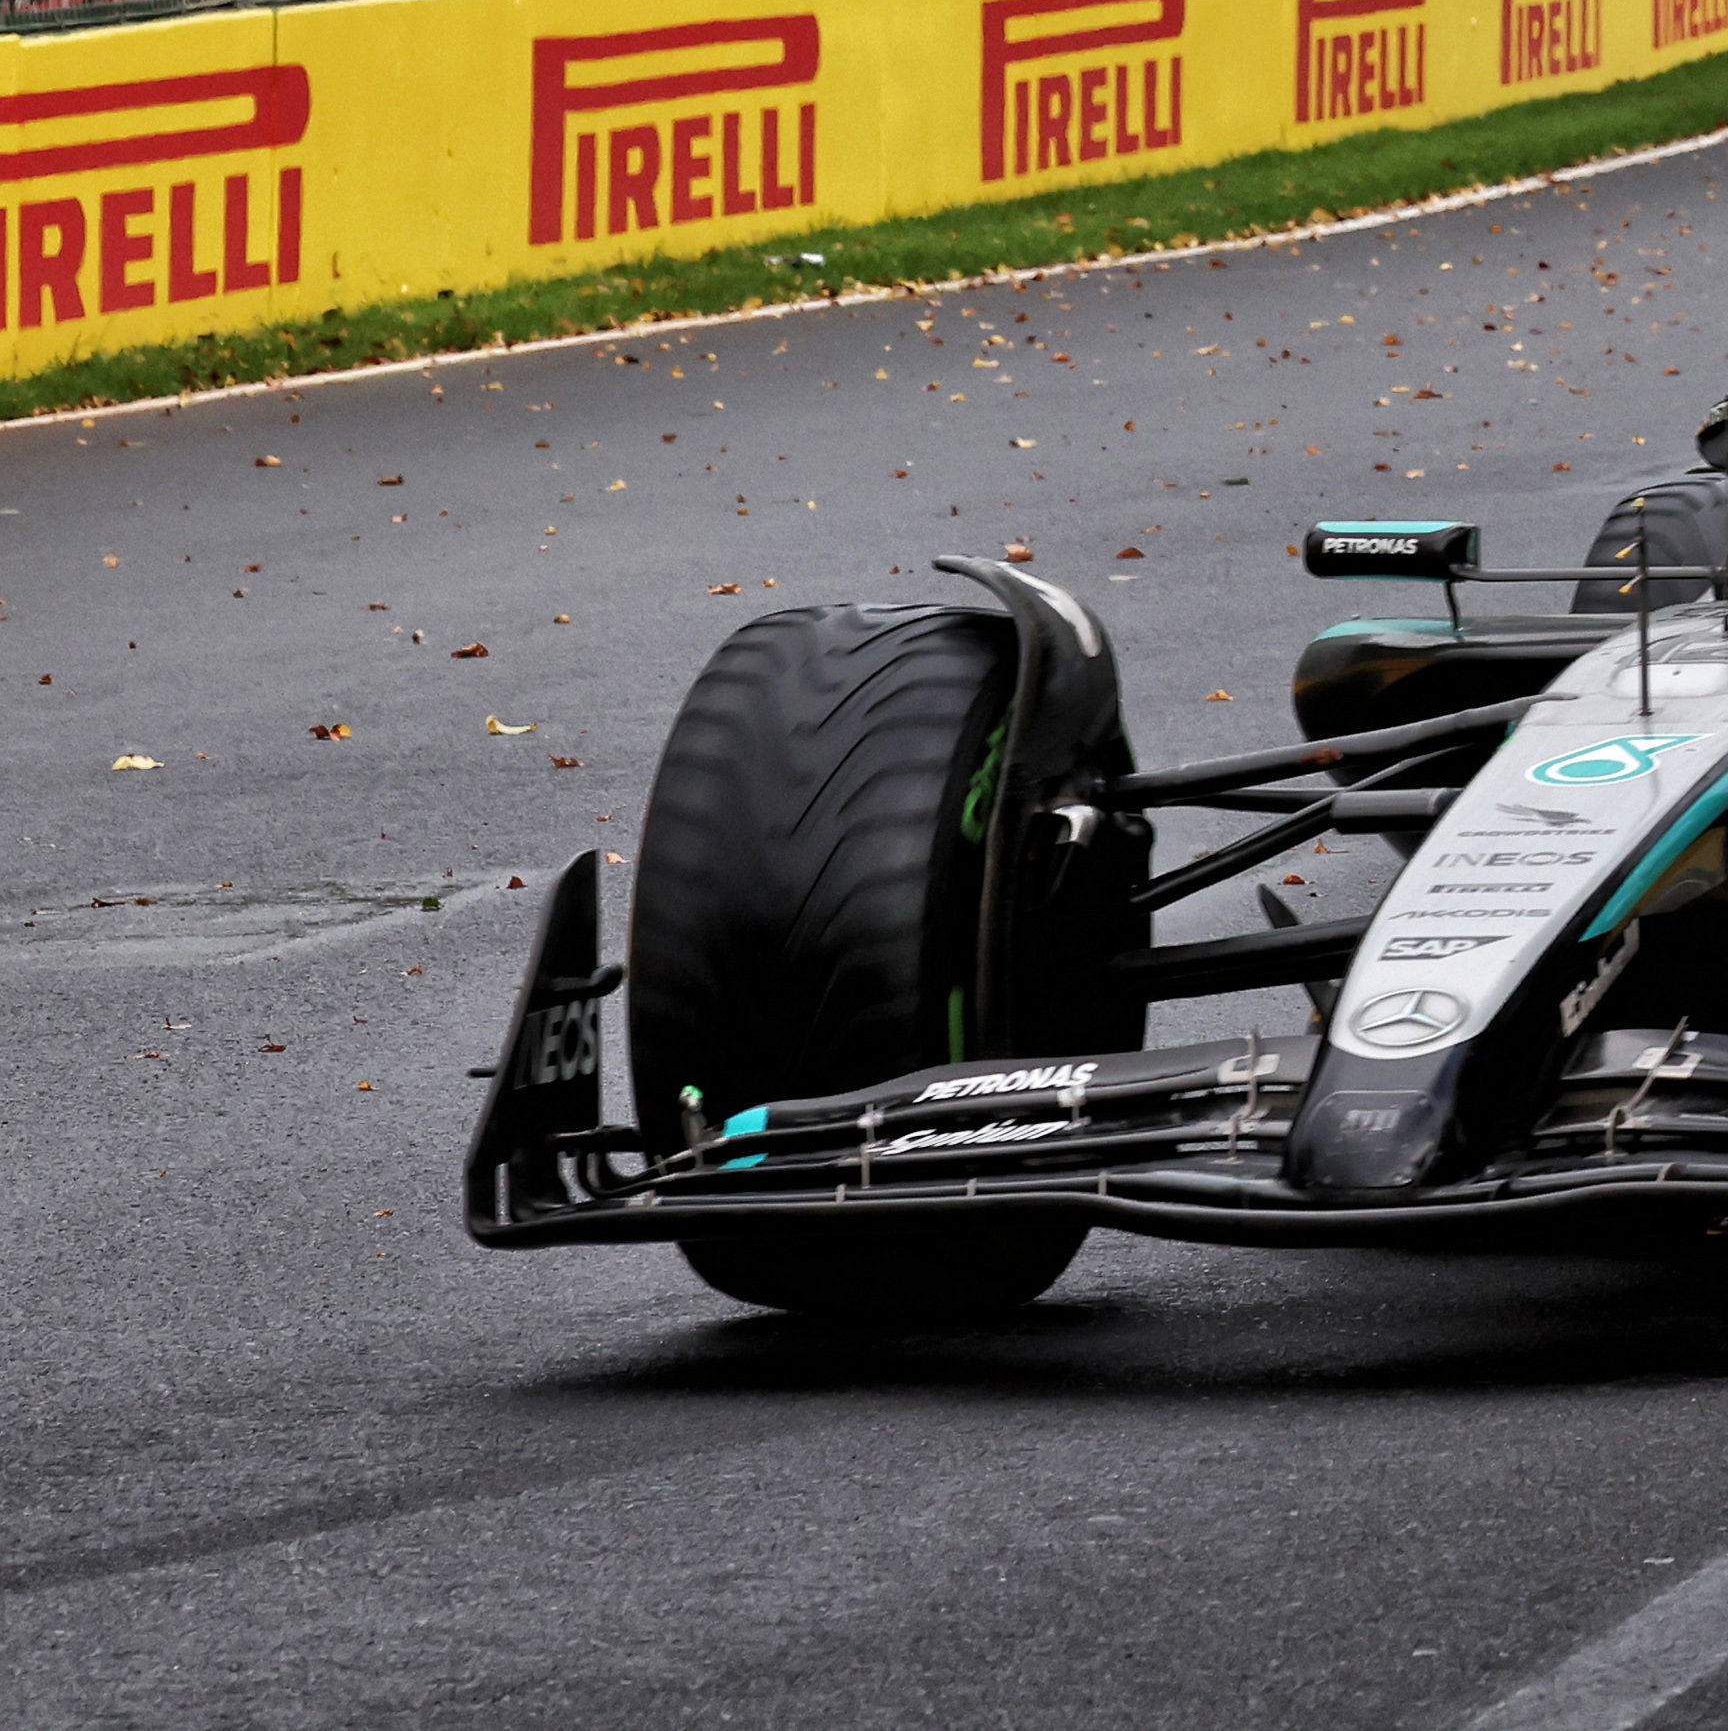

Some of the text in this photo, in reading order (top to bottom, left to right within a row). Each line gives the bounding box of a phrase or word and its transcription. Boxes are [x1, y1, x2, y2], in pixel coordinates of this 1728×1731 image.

[528, 12, 821, 246] PIRELLI
[0, 63, 313, 332] PRELLI
[1322, 537, 1419, 556] PETRONAS
[1432, 851, 1599, 869] INEOS
[1425, 882, 1555, 895] PIRELLI
[1384, 938, 1476, 958] SAP
[513, 997, 598, 1091] NEOS
[912, 1062, 1099, 1104] PETRONAS
